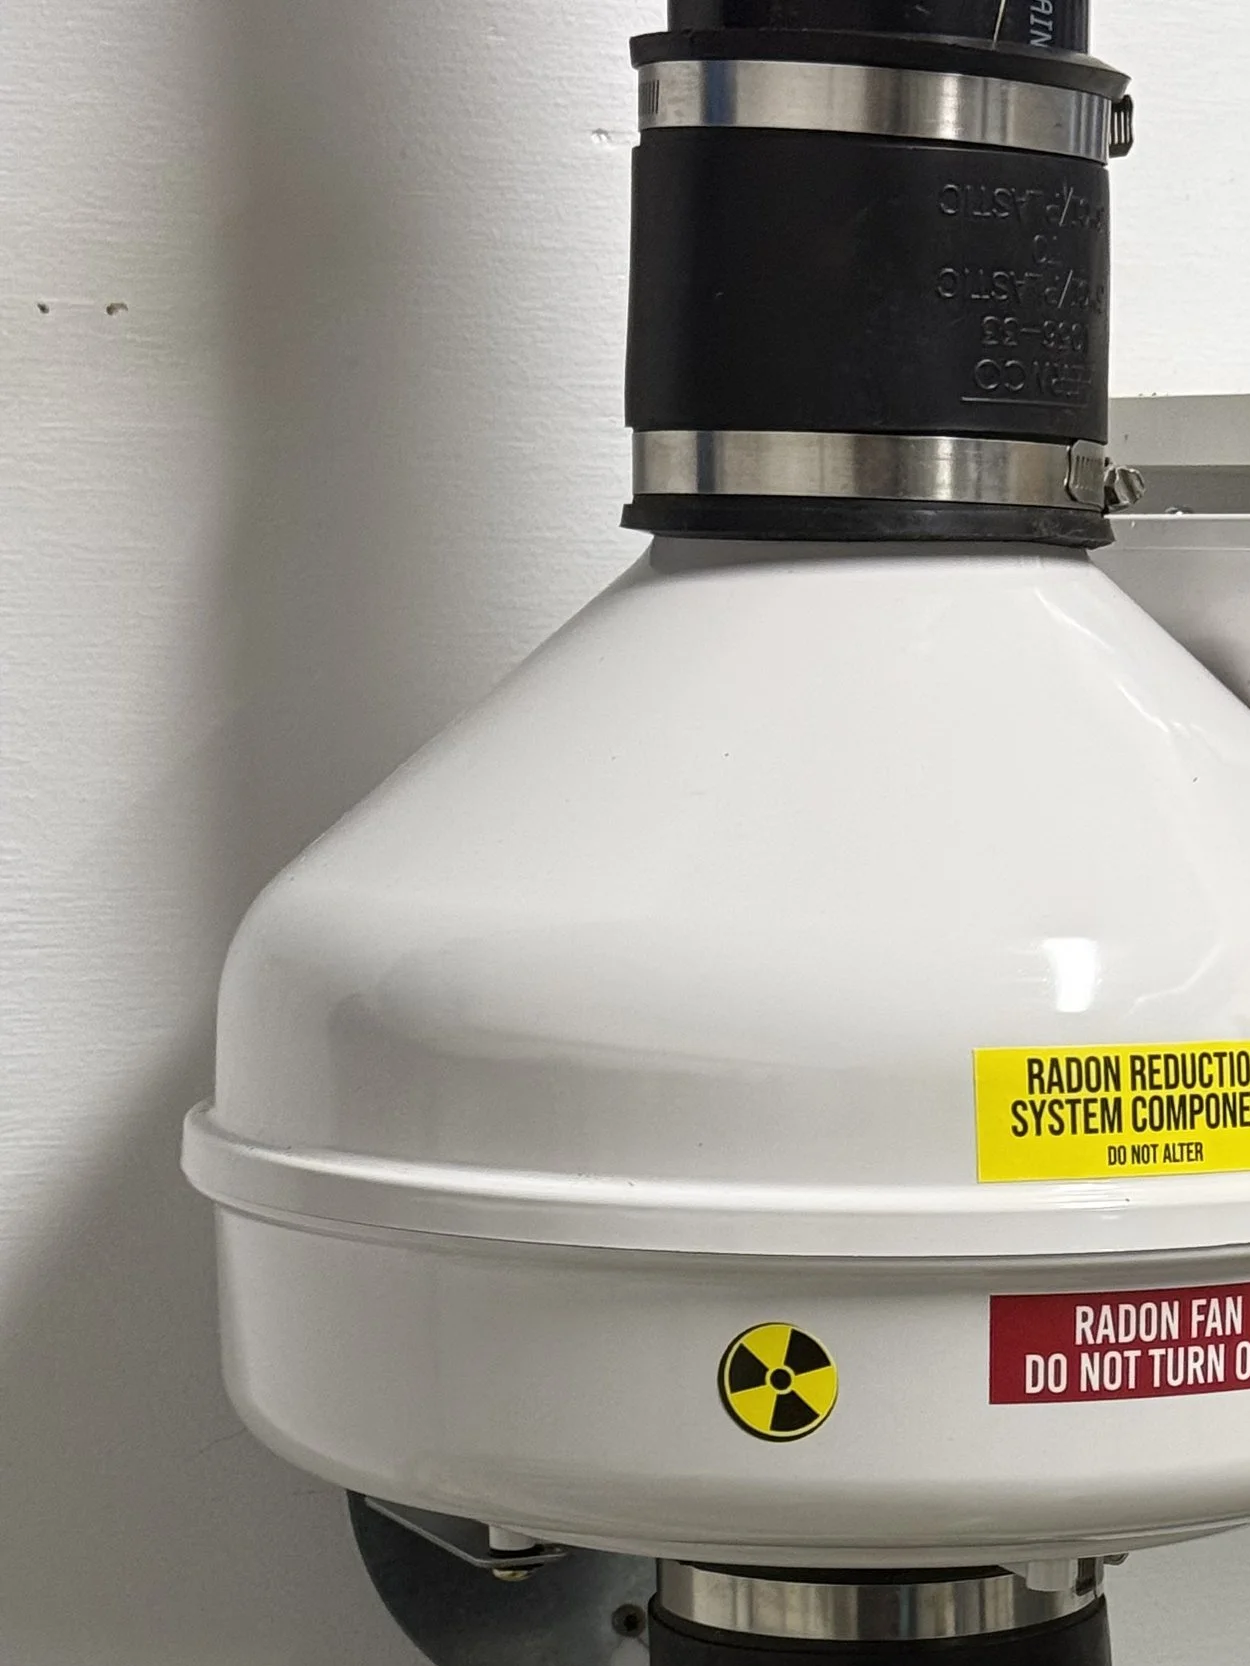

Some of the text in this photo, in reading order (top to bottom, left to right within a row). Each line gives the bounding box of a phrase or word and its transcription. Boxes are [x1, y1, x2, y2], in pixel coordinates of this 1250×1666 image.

[1027, 1055, 1121, 1094] RADON
[1011, 1097, 1123, 1137] SYSTEM
[1108, 1142, 1203, 1165] DO NOT ALTER
[1075, 1296, 1243, 1345] RADON FAN
[1025, 1353, 1067, 1394] DO
[1080, 1350, 1141, 1392] NOT
[1148, 1344, 1225, 1387] TURN
